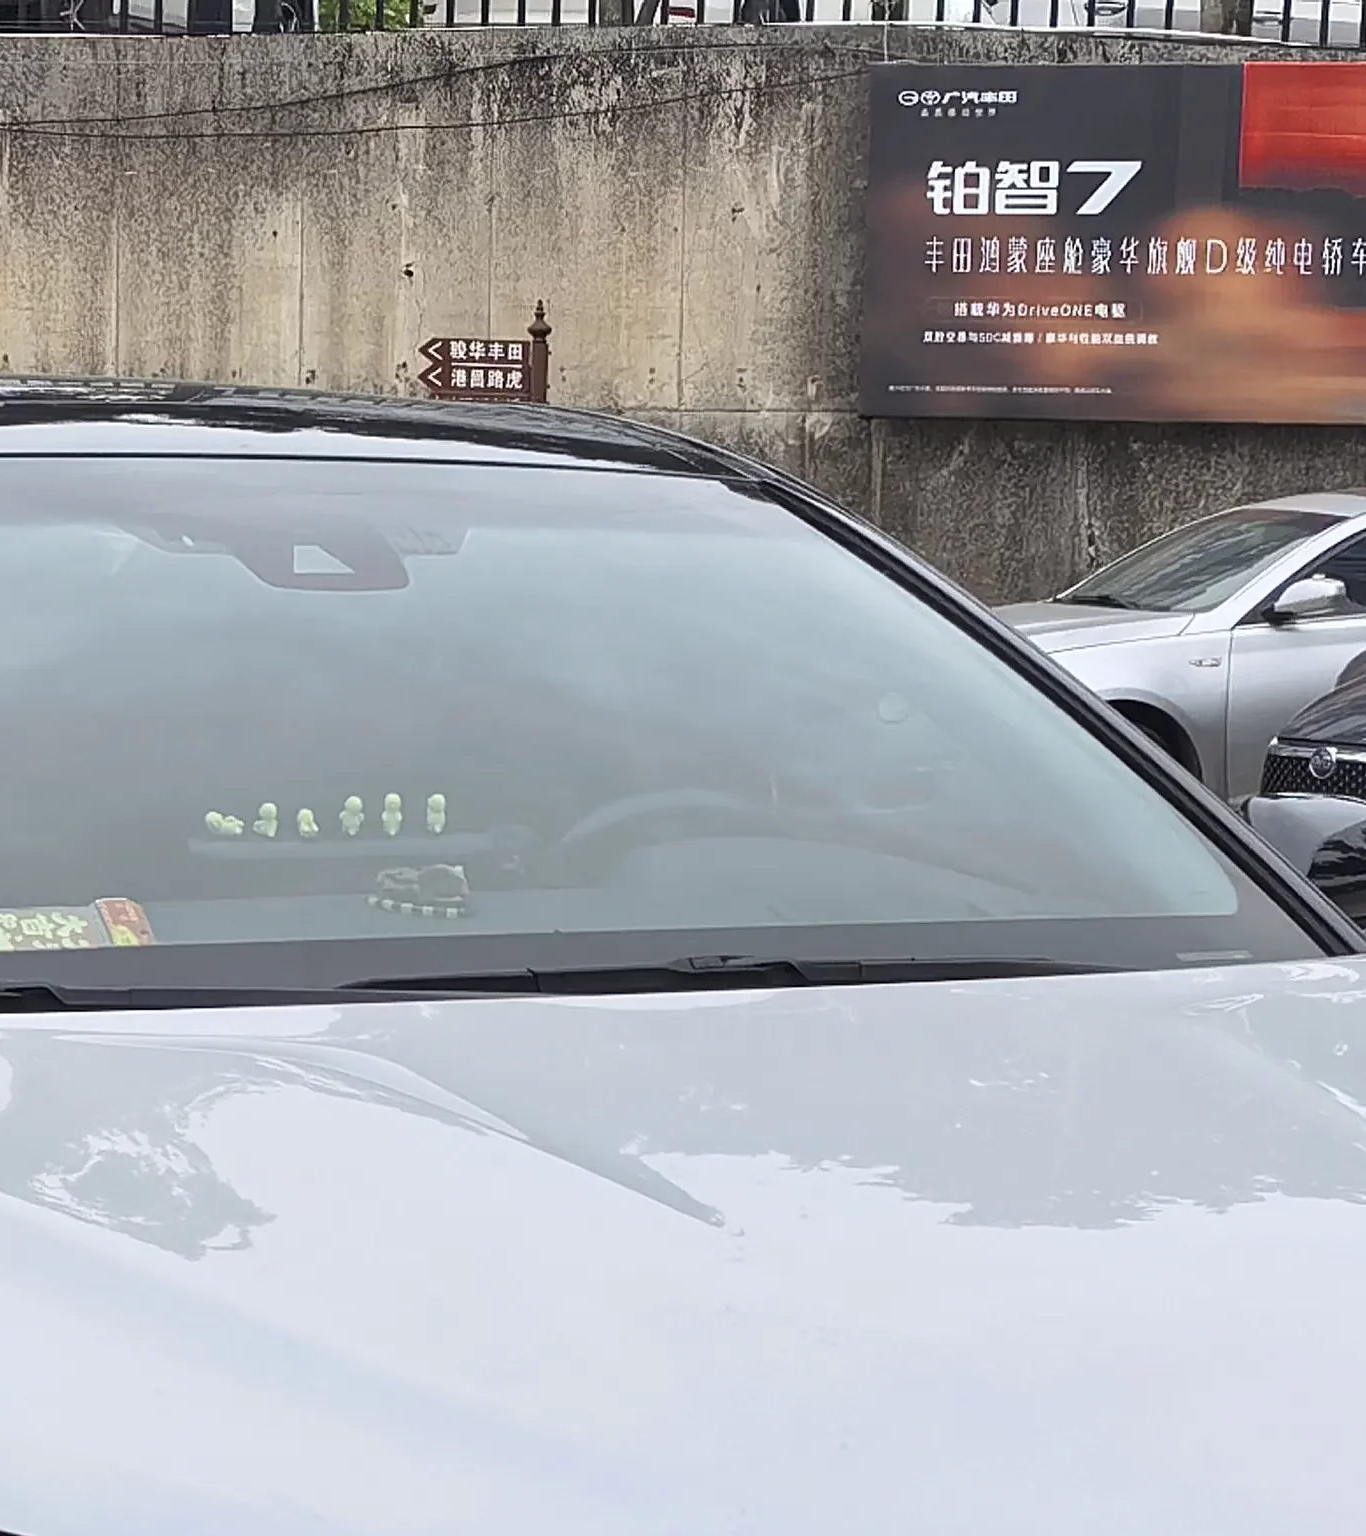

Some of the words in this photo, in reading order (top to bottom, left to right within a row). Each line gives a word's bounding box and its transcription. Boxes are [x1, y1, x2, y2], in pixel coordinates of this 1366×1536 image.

[925, 160, 1142, 216] 铂智7
[450, 340, 523, 361] 骏华丰田
[450, 369, 523, 389] 港昌路虎
